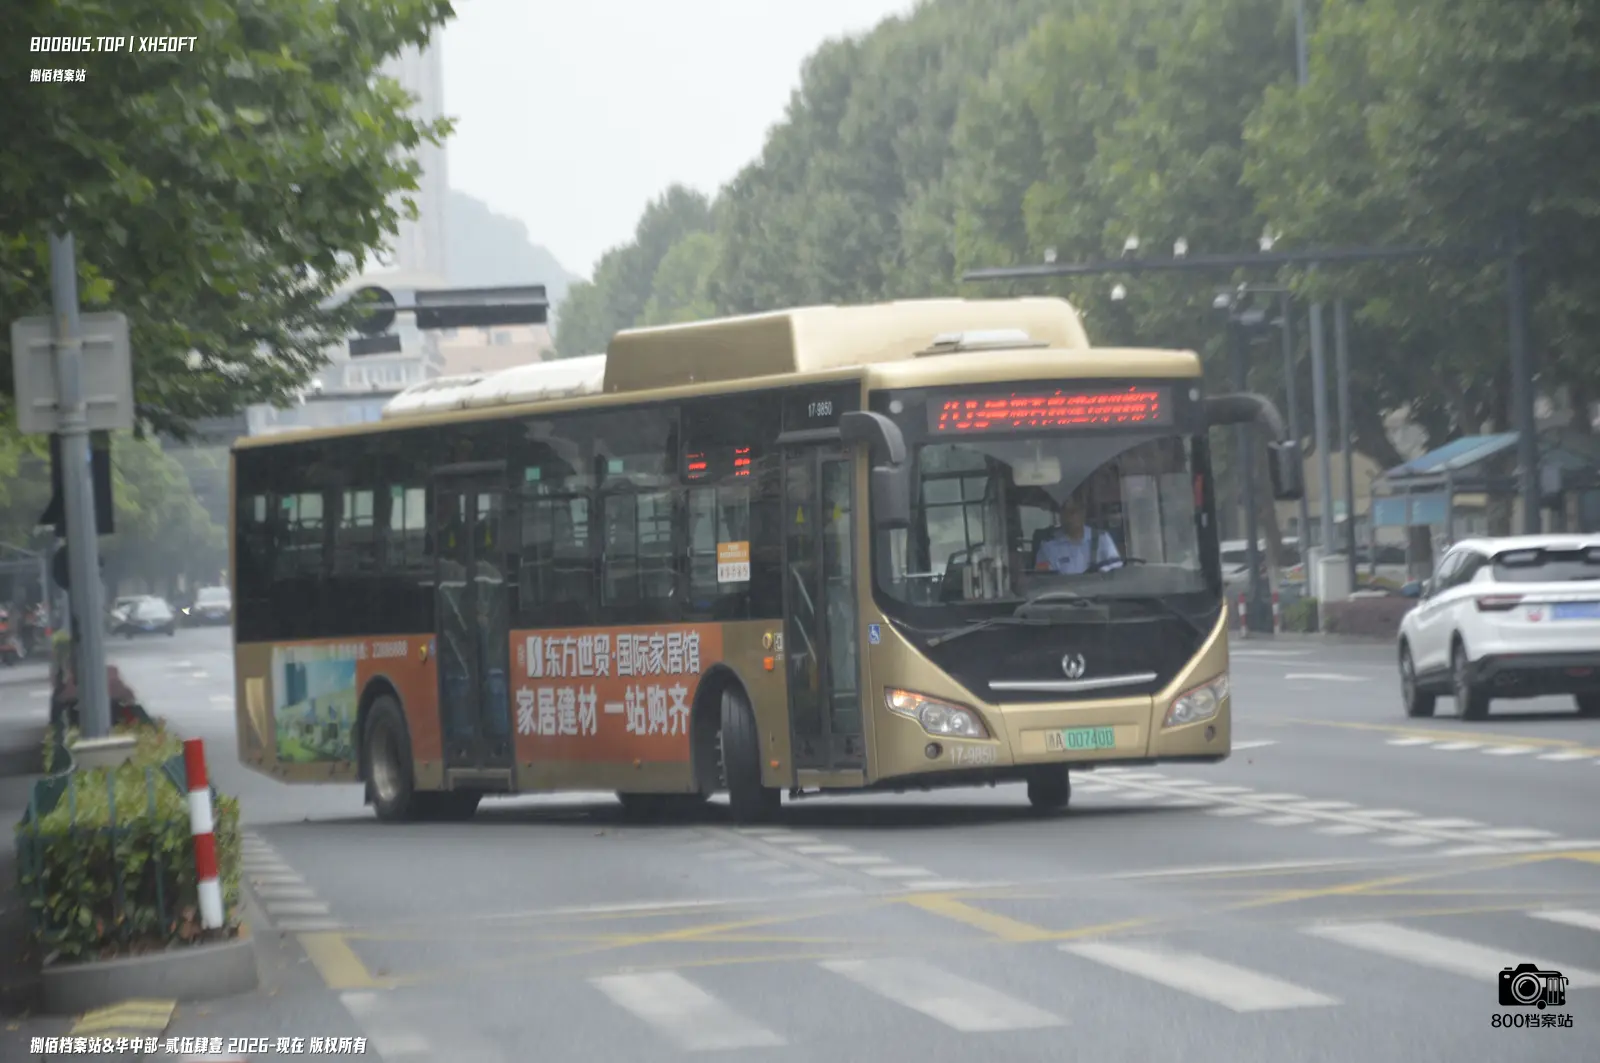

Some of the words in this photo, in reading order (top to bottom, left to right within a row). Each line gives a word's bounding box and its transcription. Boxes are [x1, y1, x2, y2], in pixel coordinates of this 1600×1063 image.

[515, 683, 599, 736] 家居建材
[603, 681, 690, 736] 一站购齐
